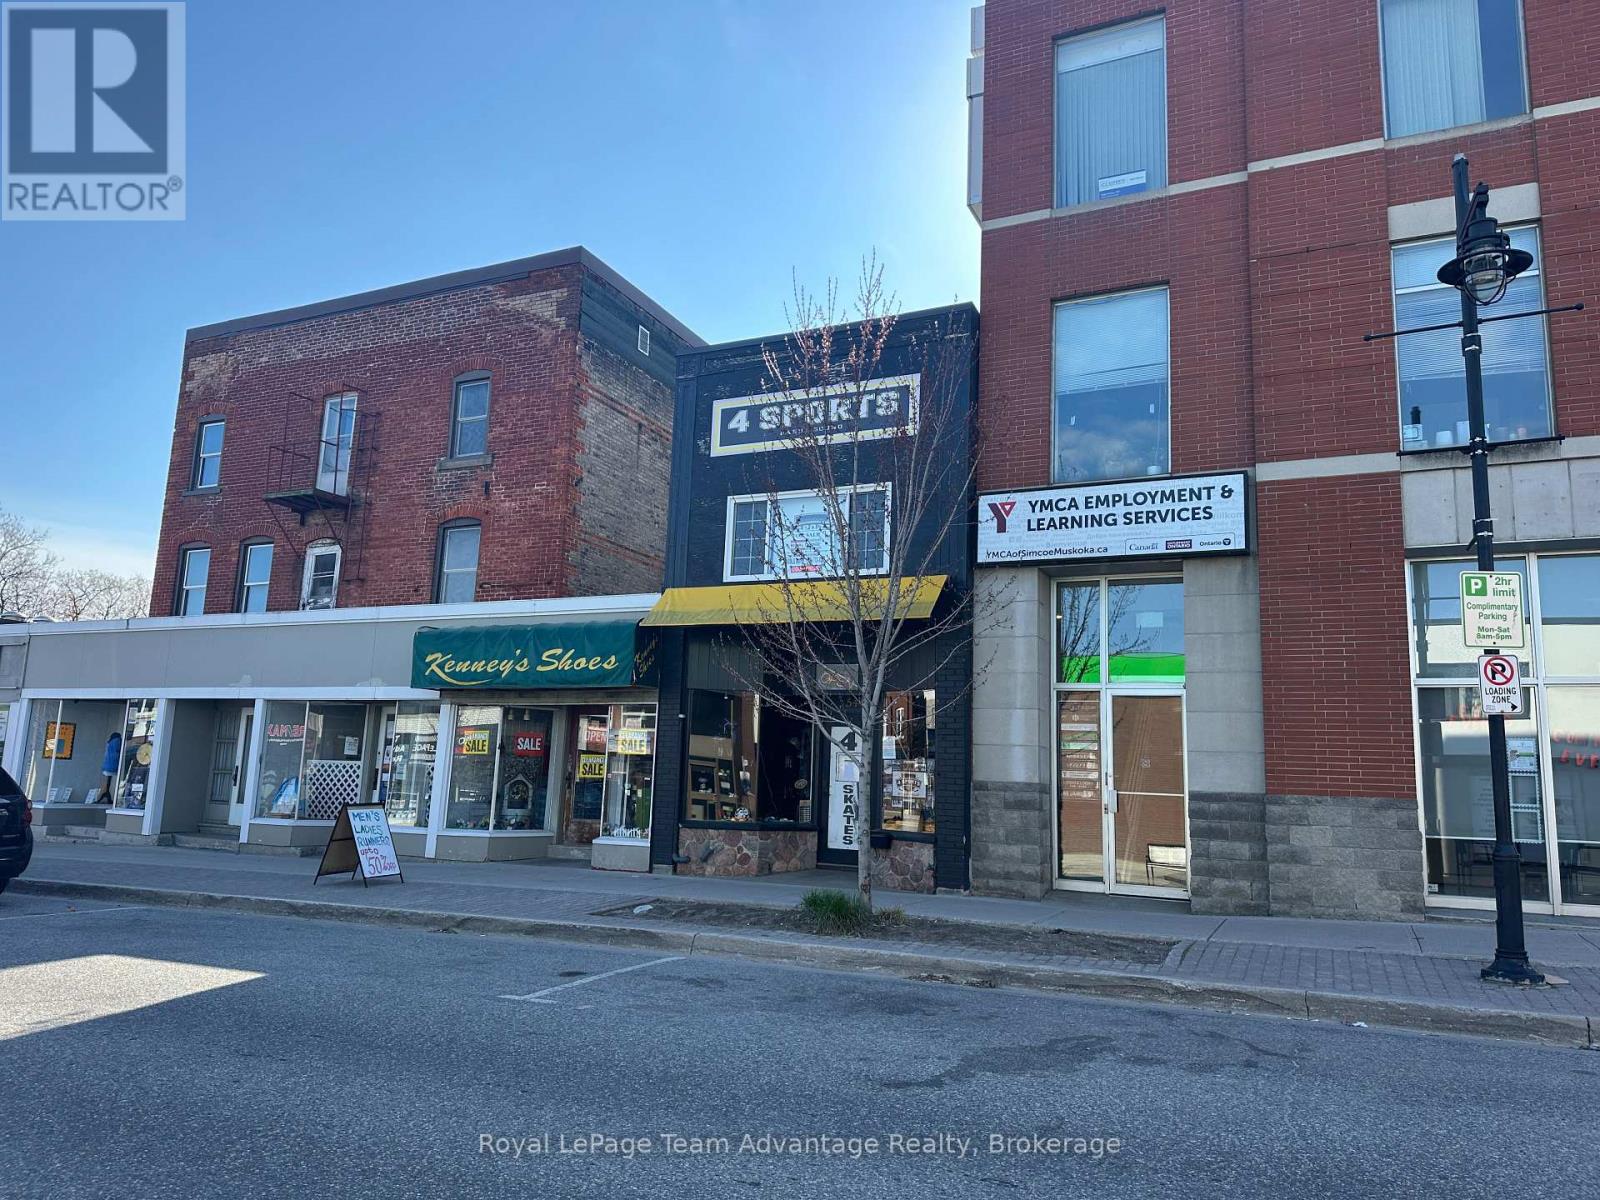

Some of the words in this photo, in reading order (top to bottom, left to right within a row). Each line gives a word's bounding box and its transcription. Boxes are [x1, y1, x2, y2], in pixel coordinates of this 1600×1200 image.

[727, 409, 750, 433] 4
[759, 390, 901, 430] SPORTS
[1028, 497, 1079, 513] YMCA
[1084, 486, 1216, 510] EMPLOYMENT
[1220, 484, 1234, 499] &
[1027, 512, 1118, 531] LEARNING
[1123, 506, 1213, 525] SERVICES
[986, 546, 1108, 559] YMCAofSimcoeMuskoka.ca
[1494, 576, 1512, 586] 2hr
[1492, 587, 1516, 597] limit
[1466, 601, 1518, 612] Complimentary
[1478, 612, 1507, 621] Parking
[425, 649, 530, 686] Kenney's
[536, 648, 619, 672] Shoes
[1485, 687, 1517, 696] LOADING
[1491, 695, 1511, 703] ZONE
[465, 739, 487, 752] SALE
[517, 737, 542, 751] SALE
[620, 738, 646, 753] SALE
[841, 732, 858, 751] 4
[582, 763, 604, 776] SALE
[351, 810, 380, 822] MEN'S
[842, 784, 855, 845] SKATES
[353, 824, 383, 836] LADIES
[356, 835, 391, 847] RUNNERS
